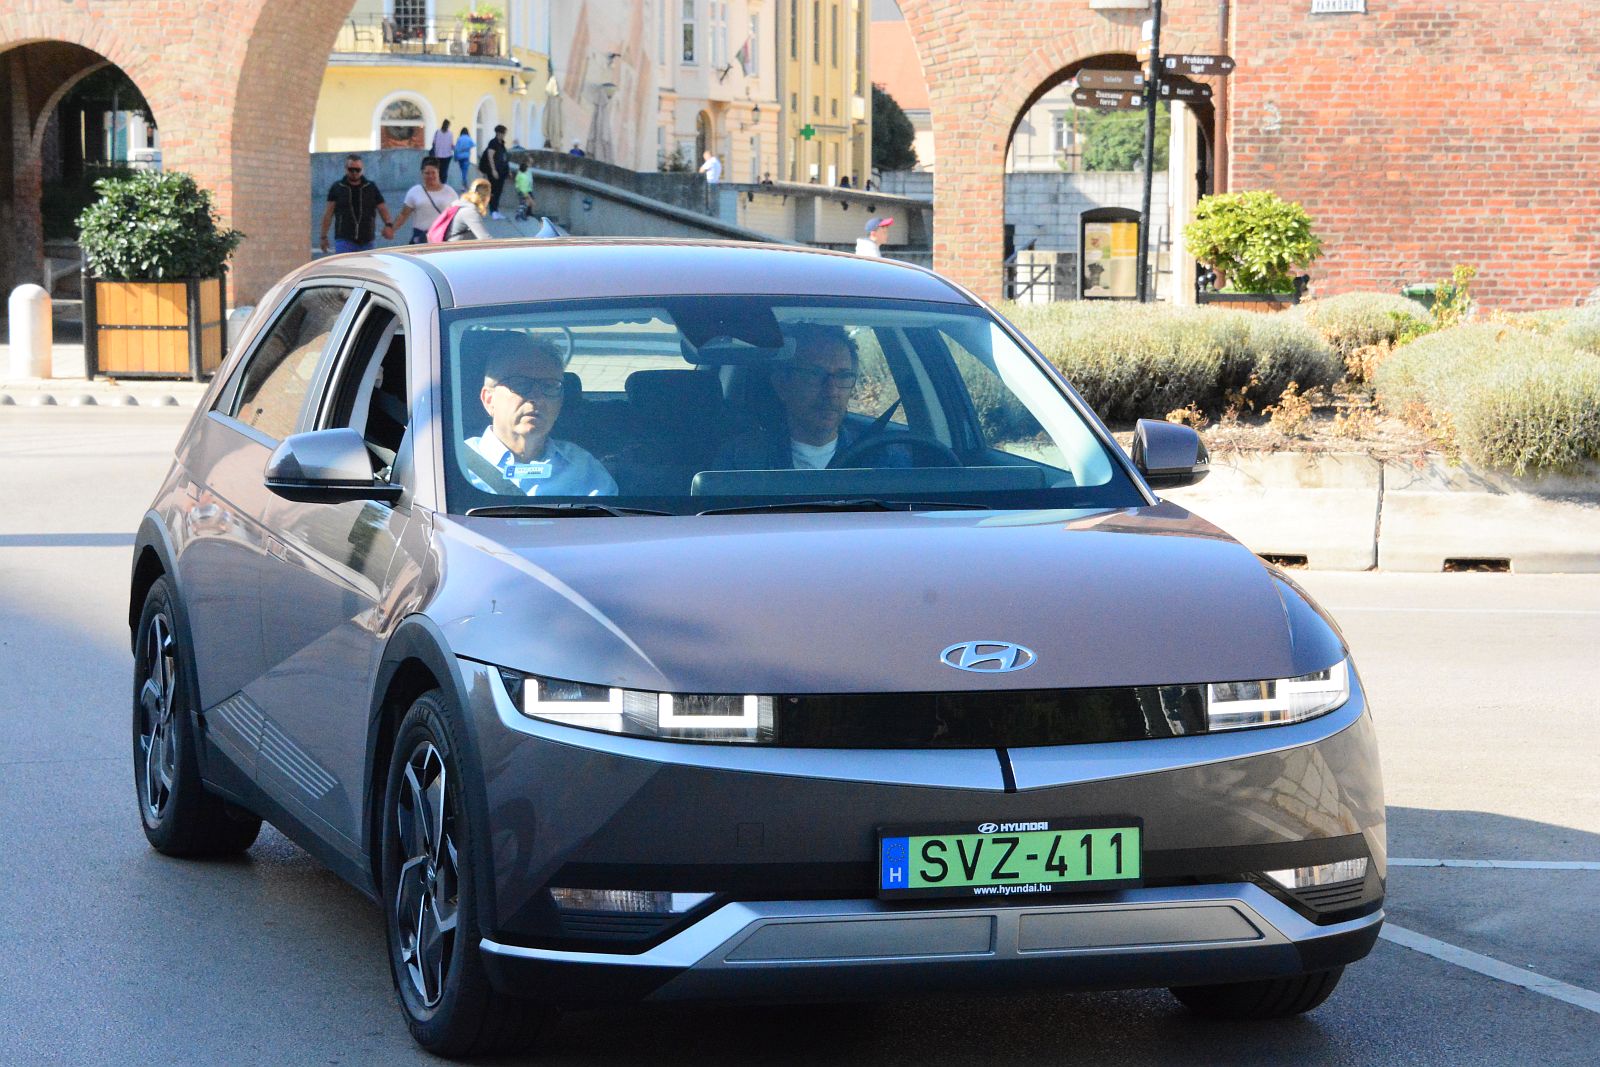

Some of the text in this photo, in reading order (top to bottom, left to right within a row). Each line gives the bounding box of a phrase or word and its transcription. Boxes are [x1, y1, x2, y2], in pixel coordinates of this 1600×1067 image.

[1000, 821, 1049, 832] HYUNDAI
[919, 832, 1123, 883] SVZ-411
[889, 867, 902, 883] H
[973, 883, 1052, 896] www.hyundai.hu
